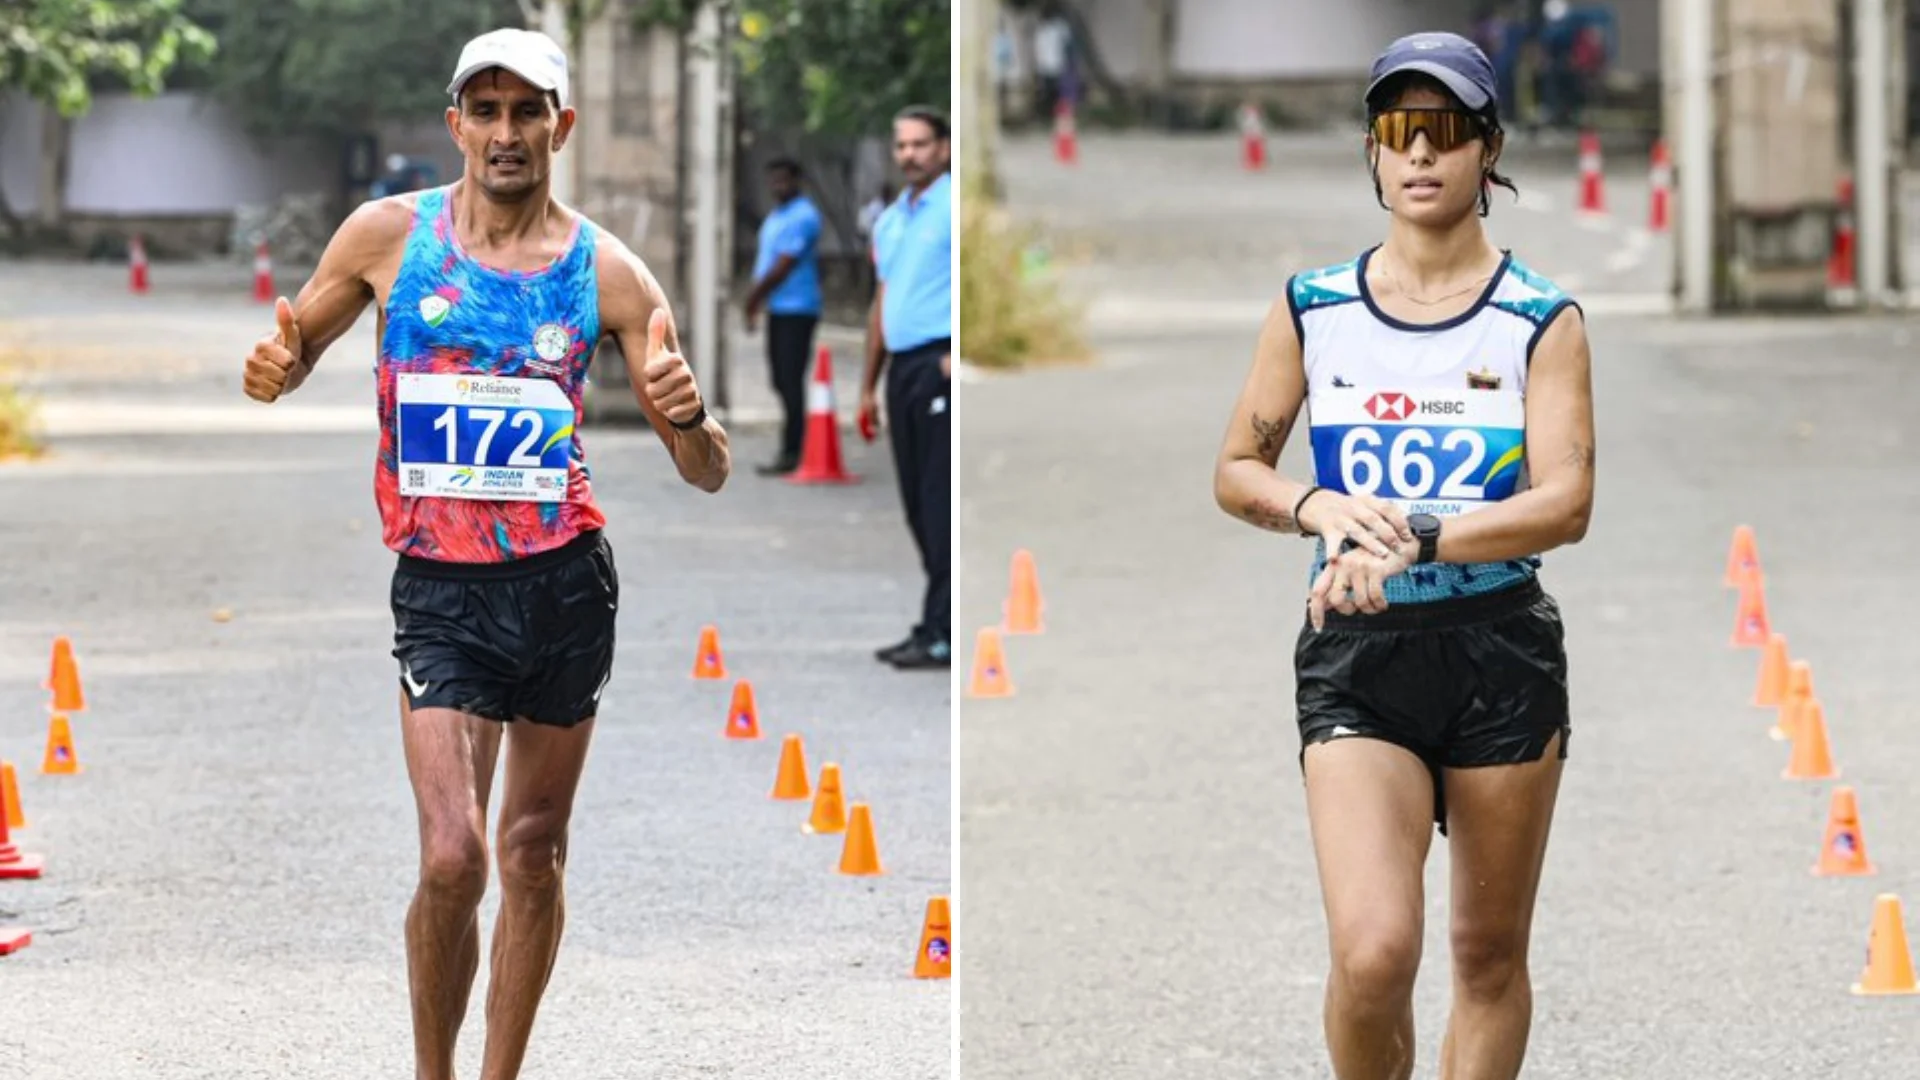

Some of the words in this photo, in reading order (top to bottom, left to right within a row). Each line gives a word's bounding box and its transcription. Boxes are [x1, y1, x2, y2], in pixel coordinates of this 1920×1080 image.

[470, 381, 522, 396] Reliance
[1421, 401, 1465, 415] HSBC
[434, 406, 543, 466] 172
[1340, 426, 1486, 499] 662
[484, 470, 525, 481] INDIAN
[1409, 503, 1462, 514] INDIAN
